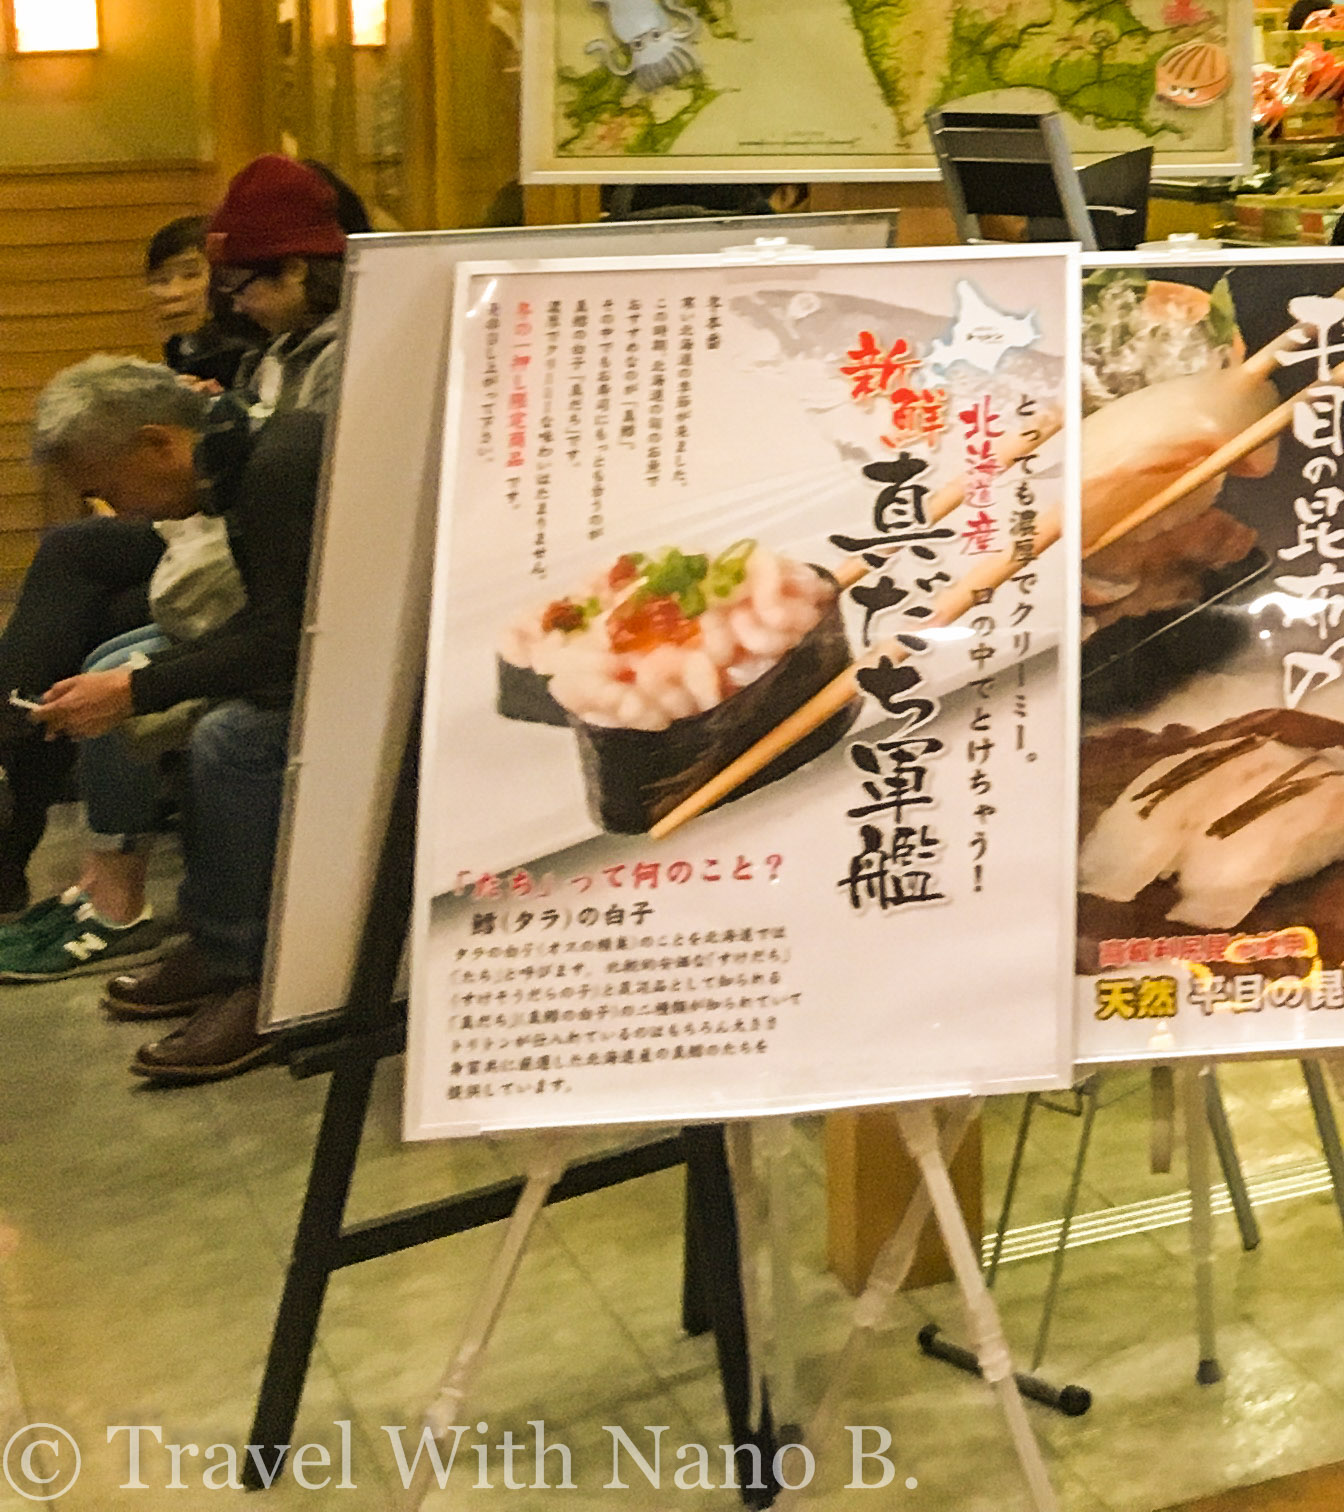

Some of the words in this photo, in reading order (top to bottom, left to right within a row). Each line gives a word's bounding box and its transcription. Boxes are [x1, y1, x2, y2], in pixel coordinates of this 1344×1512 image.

[840, 330, 949, 452] 新鮮
[959, 394, 1003, 556] 北海道産
[828, 450, 957, 911] 真だち軍艦
[1094, 975, 1178, 1021] 天然
